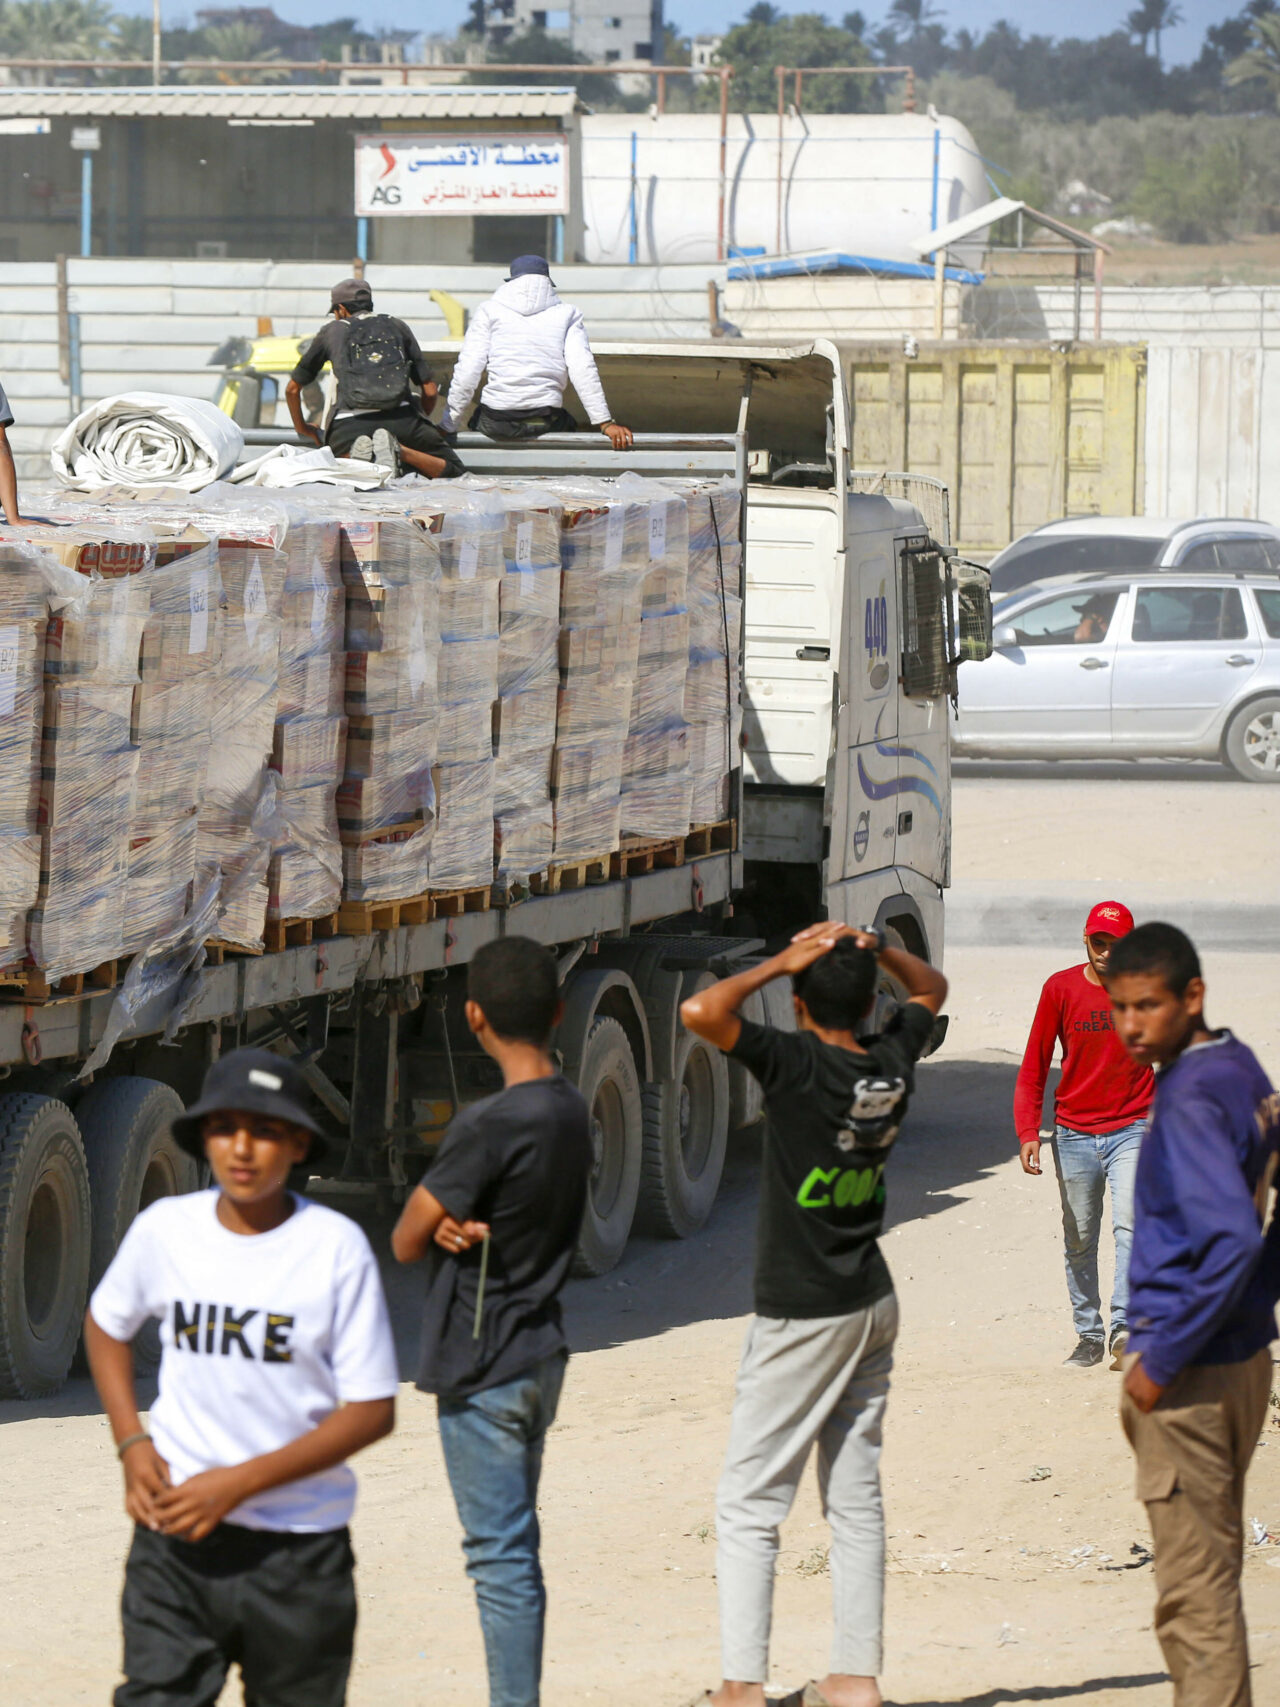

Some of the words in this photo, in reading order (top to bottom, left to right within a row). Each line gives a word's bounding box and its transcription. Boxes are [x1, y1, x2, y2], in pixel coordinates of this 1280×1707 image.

[494, 142, 560, 165] محطة
[370, 186, 402, 205] AG
[473, 183, 507, 204] الغاز
[651, 518, 664, 539] B2
[865, 596, 888, 658] 440
[1, 648, 15, 672] B2
[173, 1300, 295, 1363] NIKE
